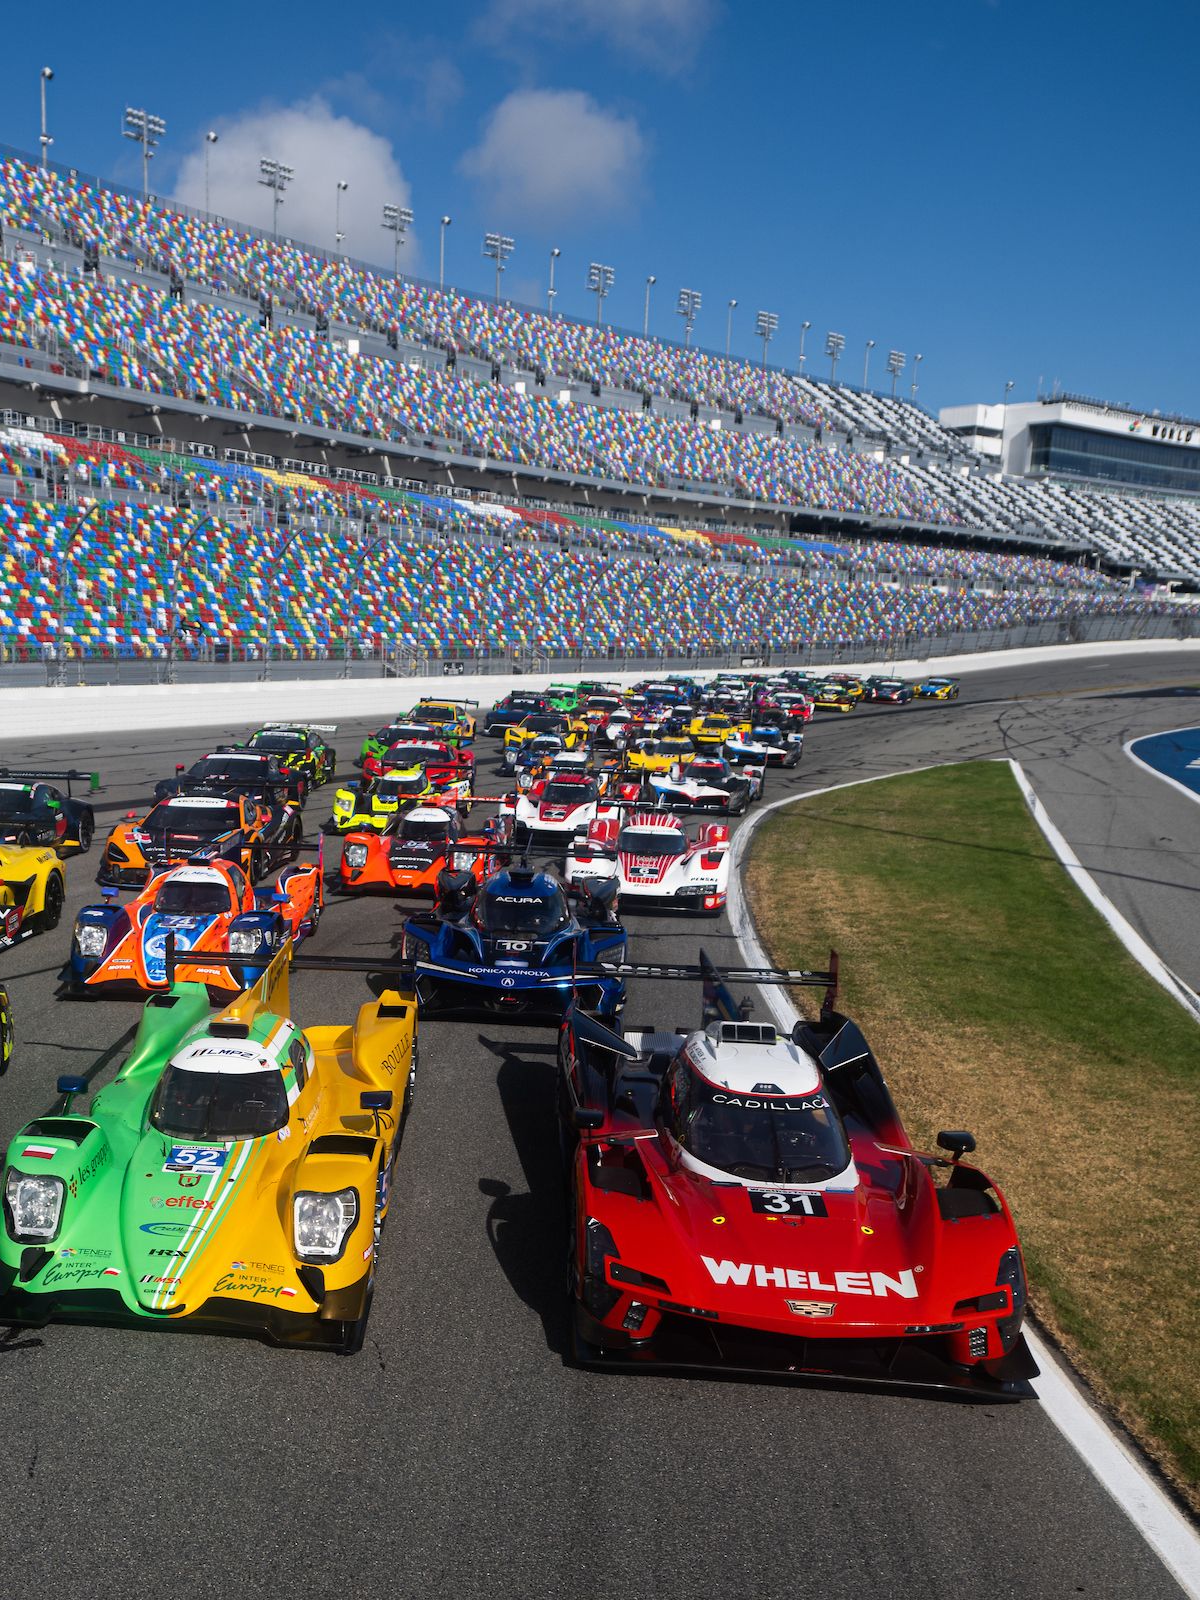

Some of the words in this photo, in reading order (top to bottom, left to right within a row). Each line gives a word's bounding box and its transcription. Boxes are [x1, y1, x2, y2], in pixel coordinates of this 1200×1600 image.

[1152, 424, 1192, 442] WORLD
[496, 896, 543, 904] ACURA
[502, 942, 528, 951] 10
[196, 968, 221, 976] MOTUL
[469, 967, 506, 975] KONICA
[508, 969, 550, 977] MINOLTA
[207, 1048, 254, 1058] LMP2
[382, 1033, 411, 1076] BOULLE
[712, 1094, 824, 1111] CADILLAC
[174, 1149, 221, 1166] 52
[77, 1166, 90, 1185] les
[165, 1195, 216, 1210] effex
[763, 1192, 815, 1215] 31
[149, 1248, 190, 1257] HRX
[43, 1263, 107, 1285] Europol
[238, 1274, 267, 1282] INTER
[700, 1255, 919, 1298] WHELEN
[213, 1273, 283, 1297] Europol
